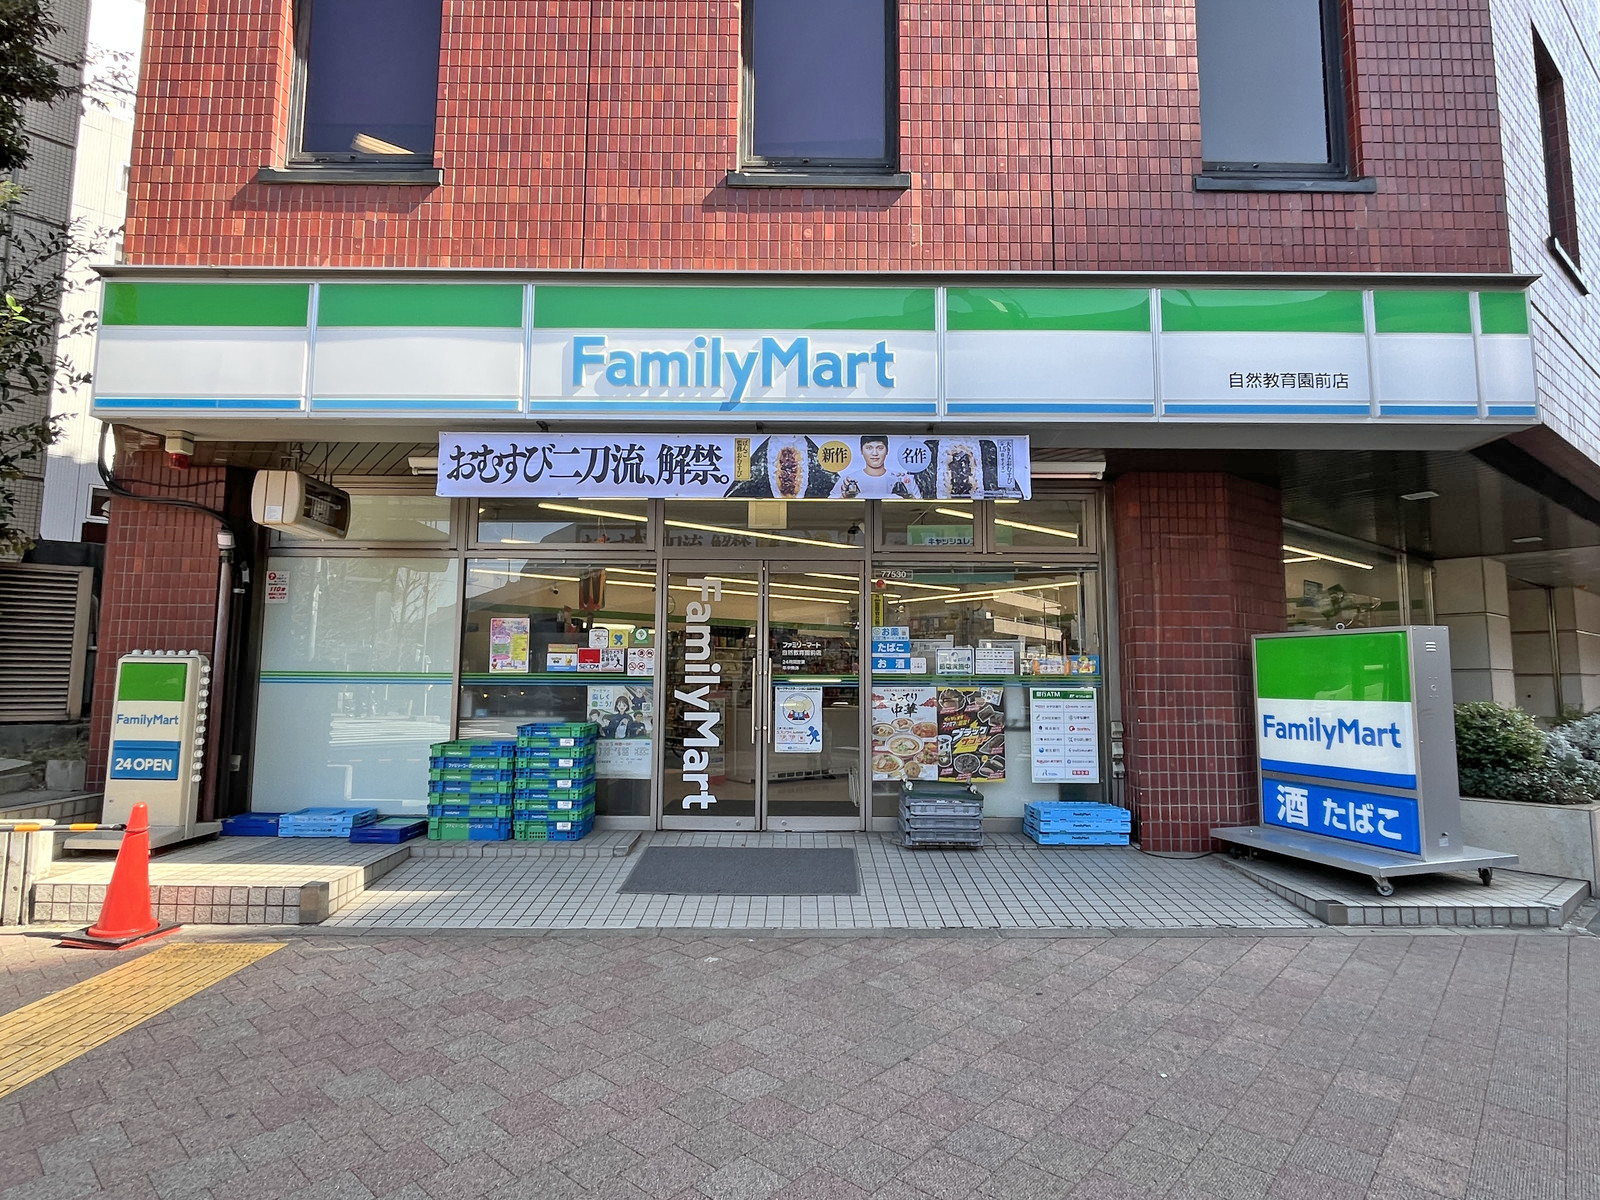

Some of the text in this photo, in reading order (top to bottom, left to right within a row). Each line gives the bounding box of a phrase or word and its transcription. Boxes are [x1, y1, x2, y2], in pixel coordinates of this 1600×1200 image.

[573, 335, 896, 411] FamilyMart
[1229, 372, 1349, 389] 自然教育園前店
[821, 447, 848, 464] 新作
[901, 447, 927, 464] 名作
[447, 443, 730, 486] おむすび二刀流、解禁。
[881, 570, 907, 578] 77530
[782, 641, 822, 649] ファミリーマート
[877, 643, 905, 653] たばこ
[674, 578, 722, 810] FamilyMart
[889, 692, 918, 702] こってり
[891, 702, 918, 718] 中華
[116, 713, 179, 727] FamilyMart
[1263, 714, 1402, 750] FamilyMart
[1276, 784, 1403, 841] 酒 たばこ
